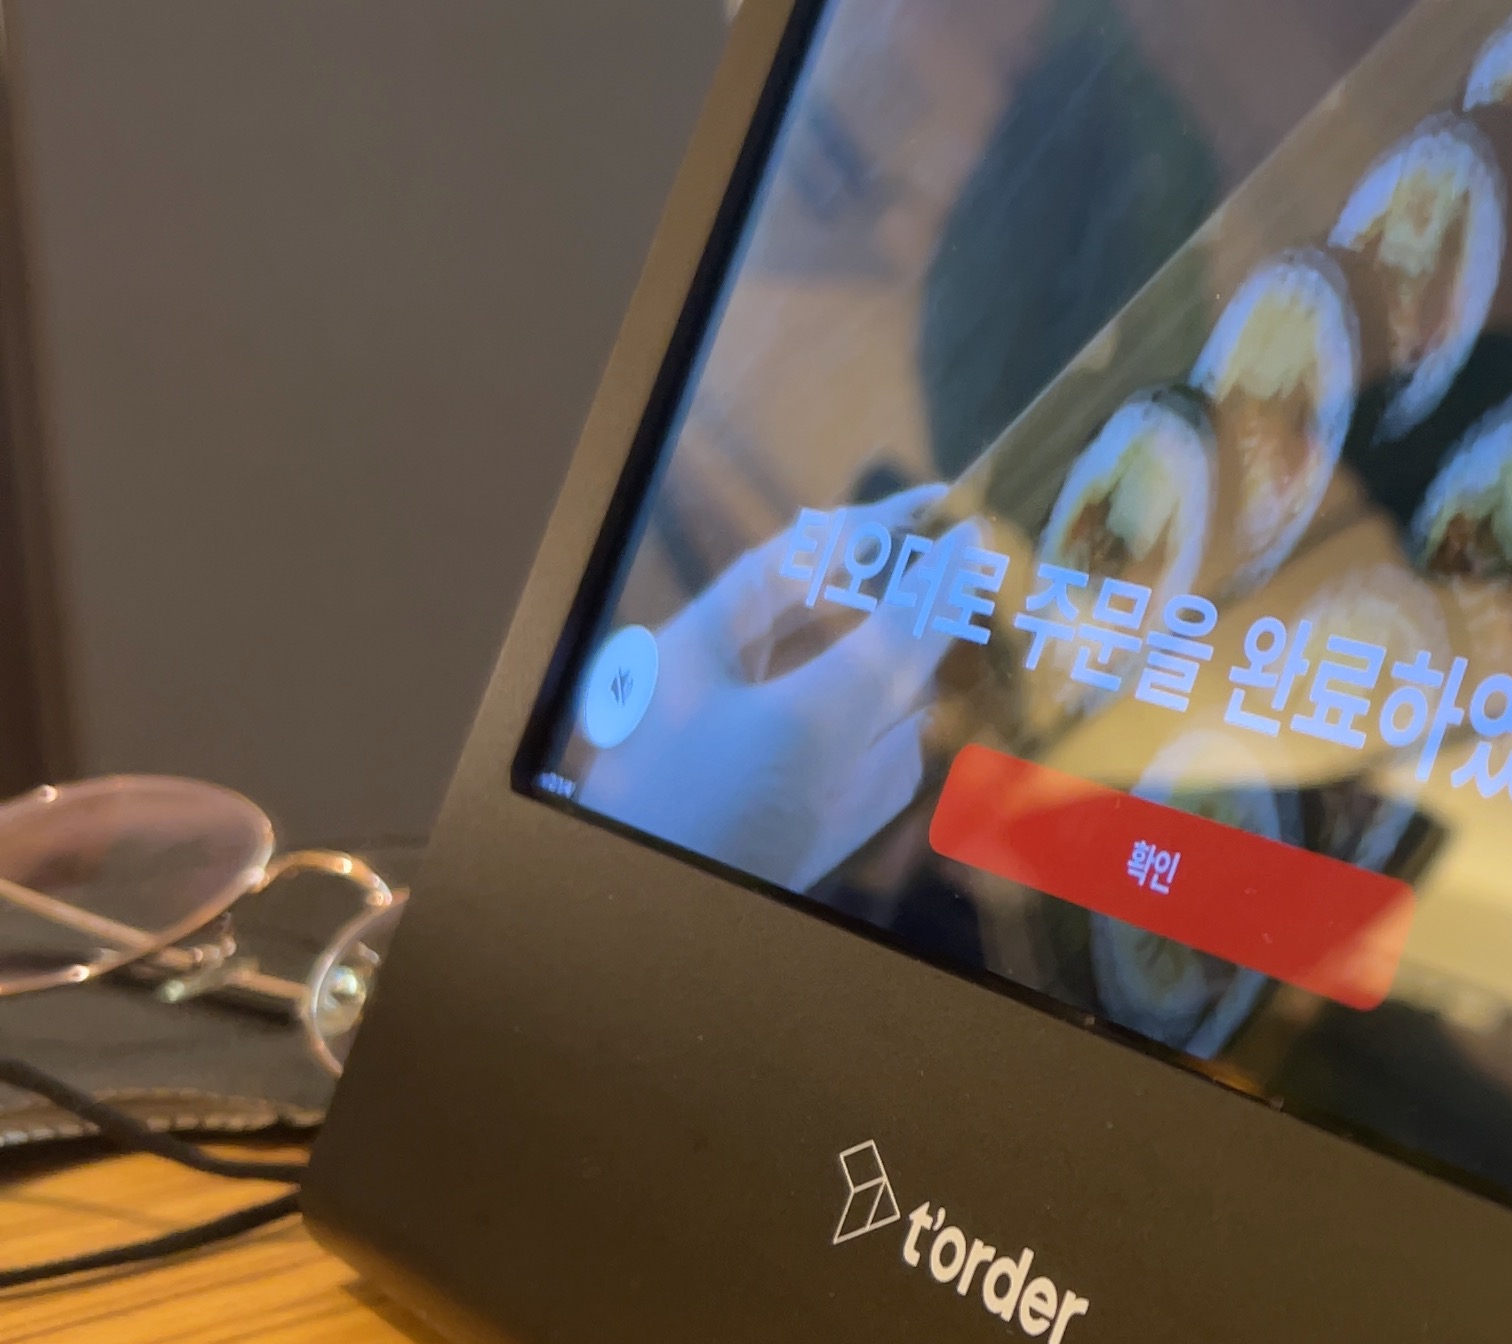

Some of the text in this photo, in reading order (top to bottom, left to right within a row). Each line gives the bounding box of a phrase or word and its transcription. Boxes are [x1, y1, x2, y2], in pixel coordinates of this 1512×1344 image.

[779, 507, 1010, 645] 티오더로
[1014, 563, 1218, 713] 주문을
[1126, 840, 1181, 895] 확인
